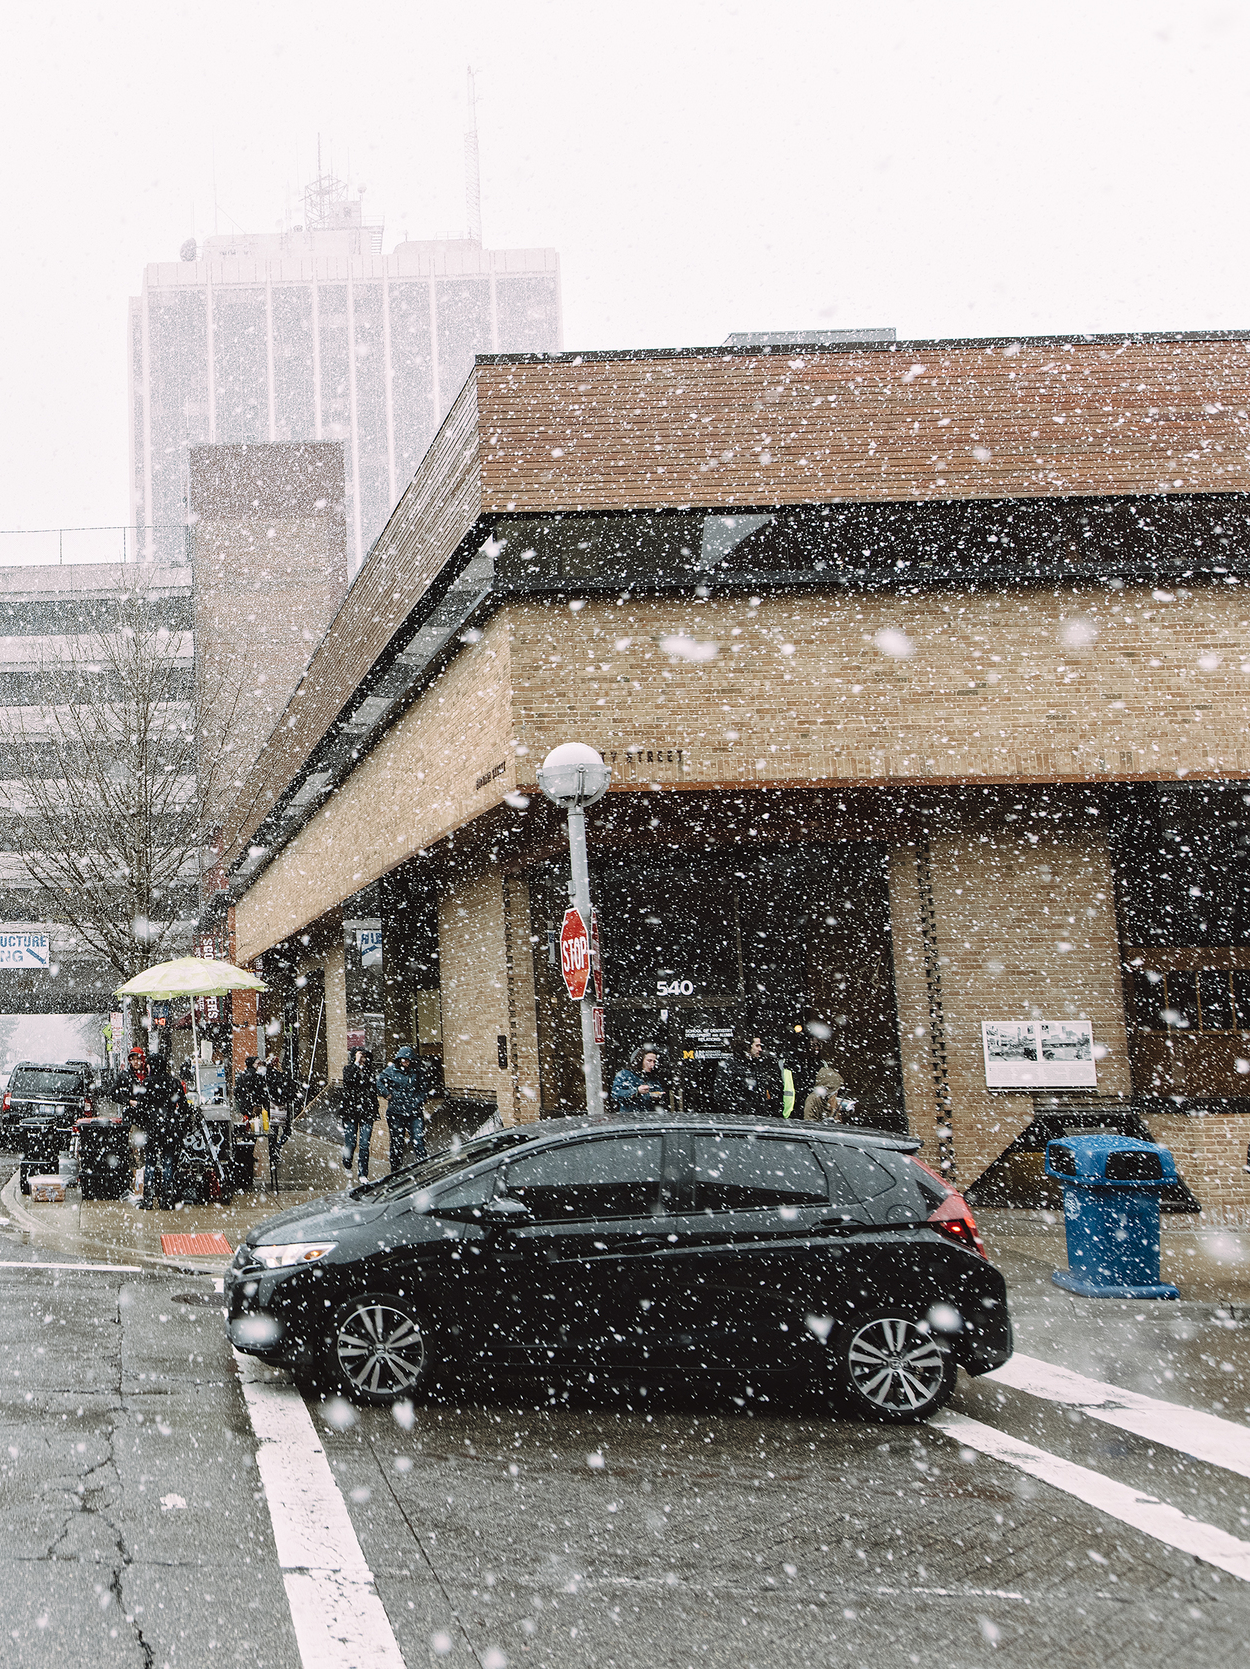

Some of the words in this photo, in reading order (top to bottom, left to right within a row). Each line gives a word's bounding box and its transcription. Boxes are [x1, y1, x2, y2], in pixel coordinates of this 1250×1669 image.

[626, 750, 684, 763] STREET
[562, 936, 587, 972] STOP
[656, 980, 694, 996] 540
